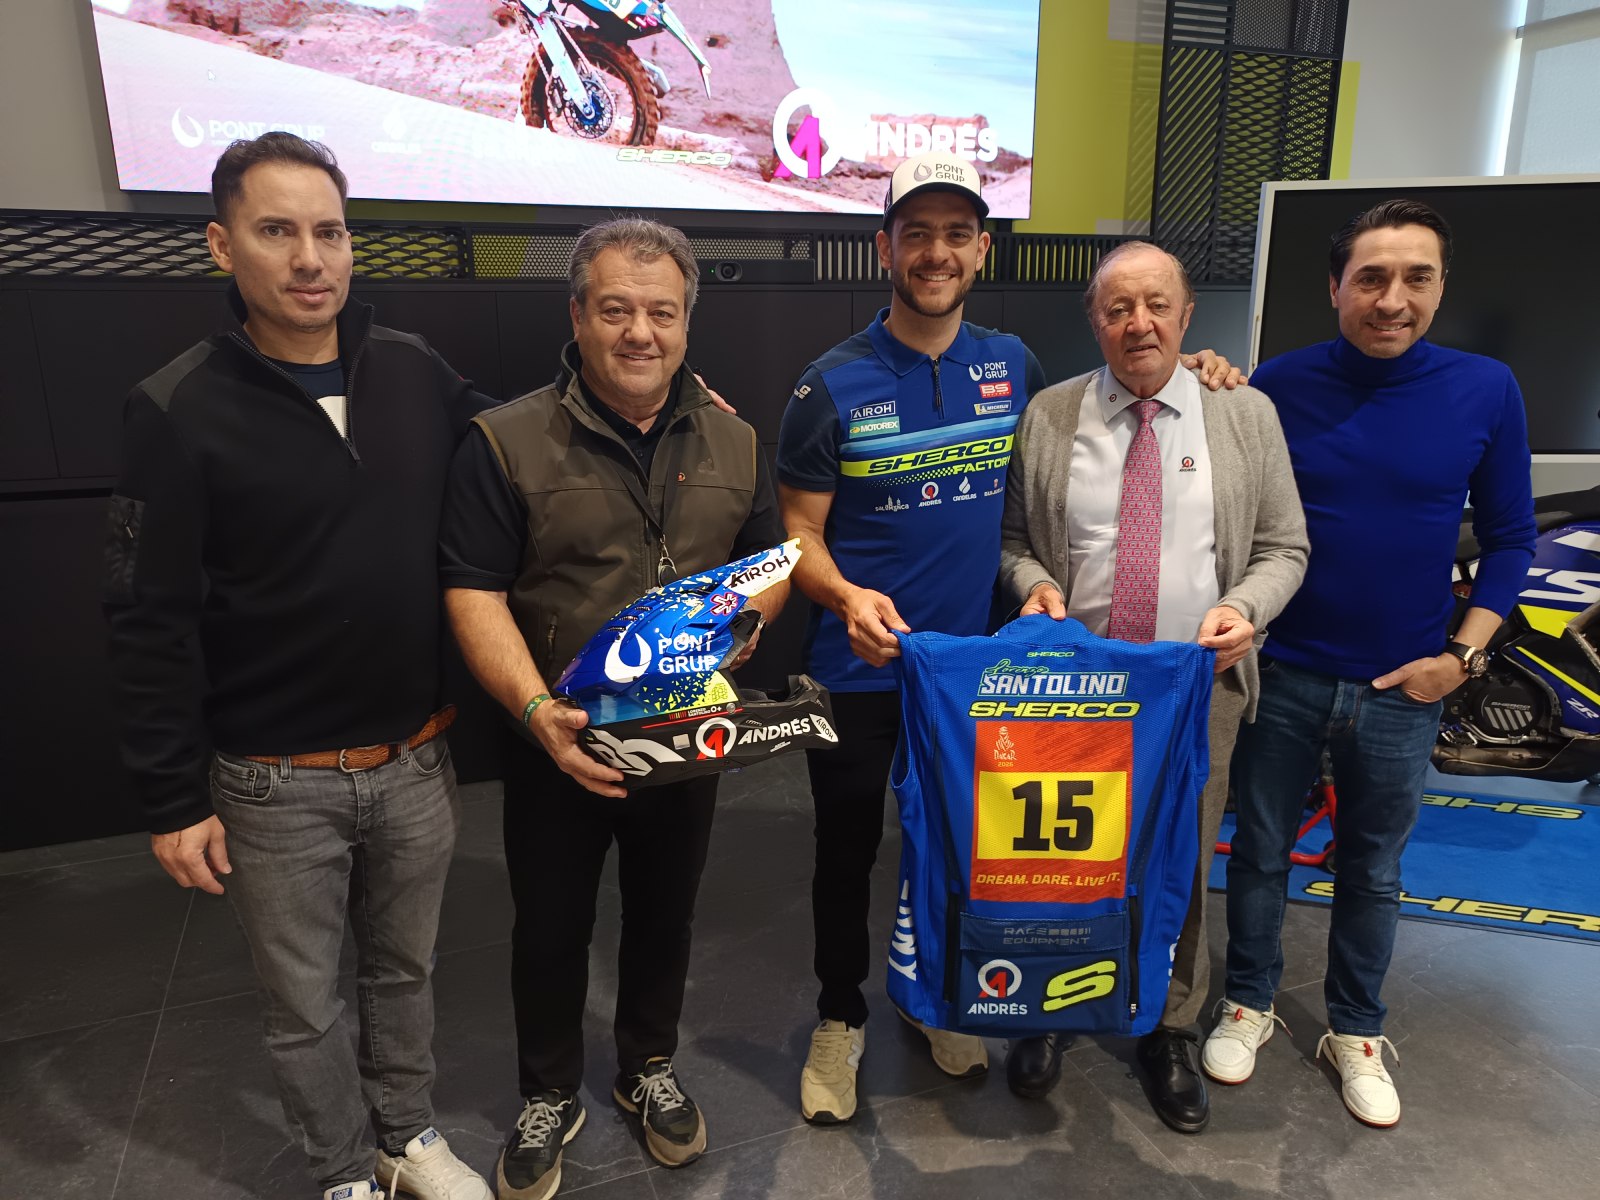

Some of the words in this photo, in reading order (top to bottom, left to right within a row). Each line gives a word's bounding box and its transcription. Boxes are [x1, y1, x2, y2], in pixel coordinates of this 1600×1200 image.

[208, 119, 264, 140] PONT
[616, 148, 732, 165] SHERCO
[935, 163, 964, 175] PONT
[935, 172, 965, 183] GRUP
[984, 361, 1007, 371] PONT
[985, 369, 1008, 379] GRUP
[981, 383, 1009, 395] BS
[853, 403, 893, 419] AIROH
[860, 420, 899, 433] MOTOREX
[867, 438, 1007, 474] SHERCO
[729, 555, 791, 588] AIROH
[658, 630, 716, 655] PONT
[658, 655, 716, 675] GRUP
[979, 673, 1125, 695] SANTOLINO
[969, 701, 1139, 718] SHERCO
[738, 716, 811, 745] ANDRÉS
[815, 718, 834, 740] AIROH
[1012, 780, 1094, 851] 15
[976, 873, 1029, 885] DREAM.
[1032, 874, 1073, 886] DARE.
[1076, 874, 1105, 887] LIVE
[1004, 927, 1047, 936] RACE
[1002, 936, 1090, 946] EQUIPMENT
[967, 1003, 1027, 1015] ANDRÉS
